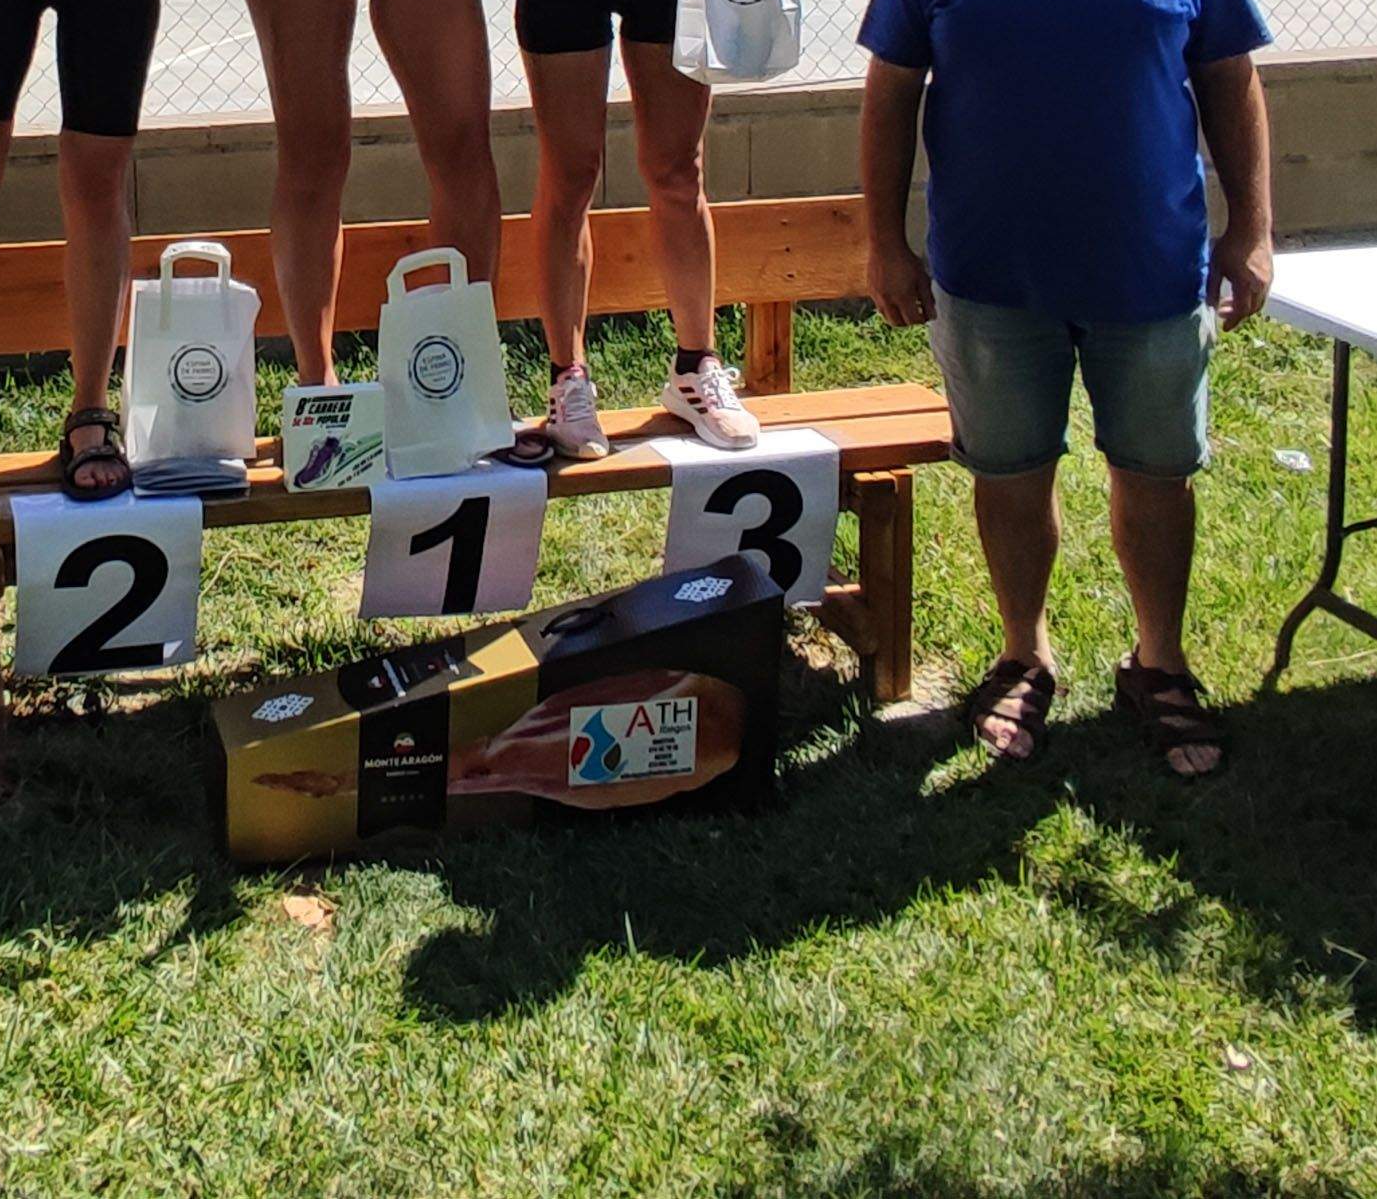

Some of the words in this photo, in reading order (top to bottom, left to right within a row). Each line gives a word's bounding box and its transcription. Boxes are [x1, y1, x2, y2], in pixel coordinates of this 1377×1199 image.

[409, 495, 492, 615] 1
[703, 468, 804, 593] 3
[47, 534, 170, 674] 2
[363, 755, 401, 770] MONTE
[401, 752, 444, 767] ARAGÓN
